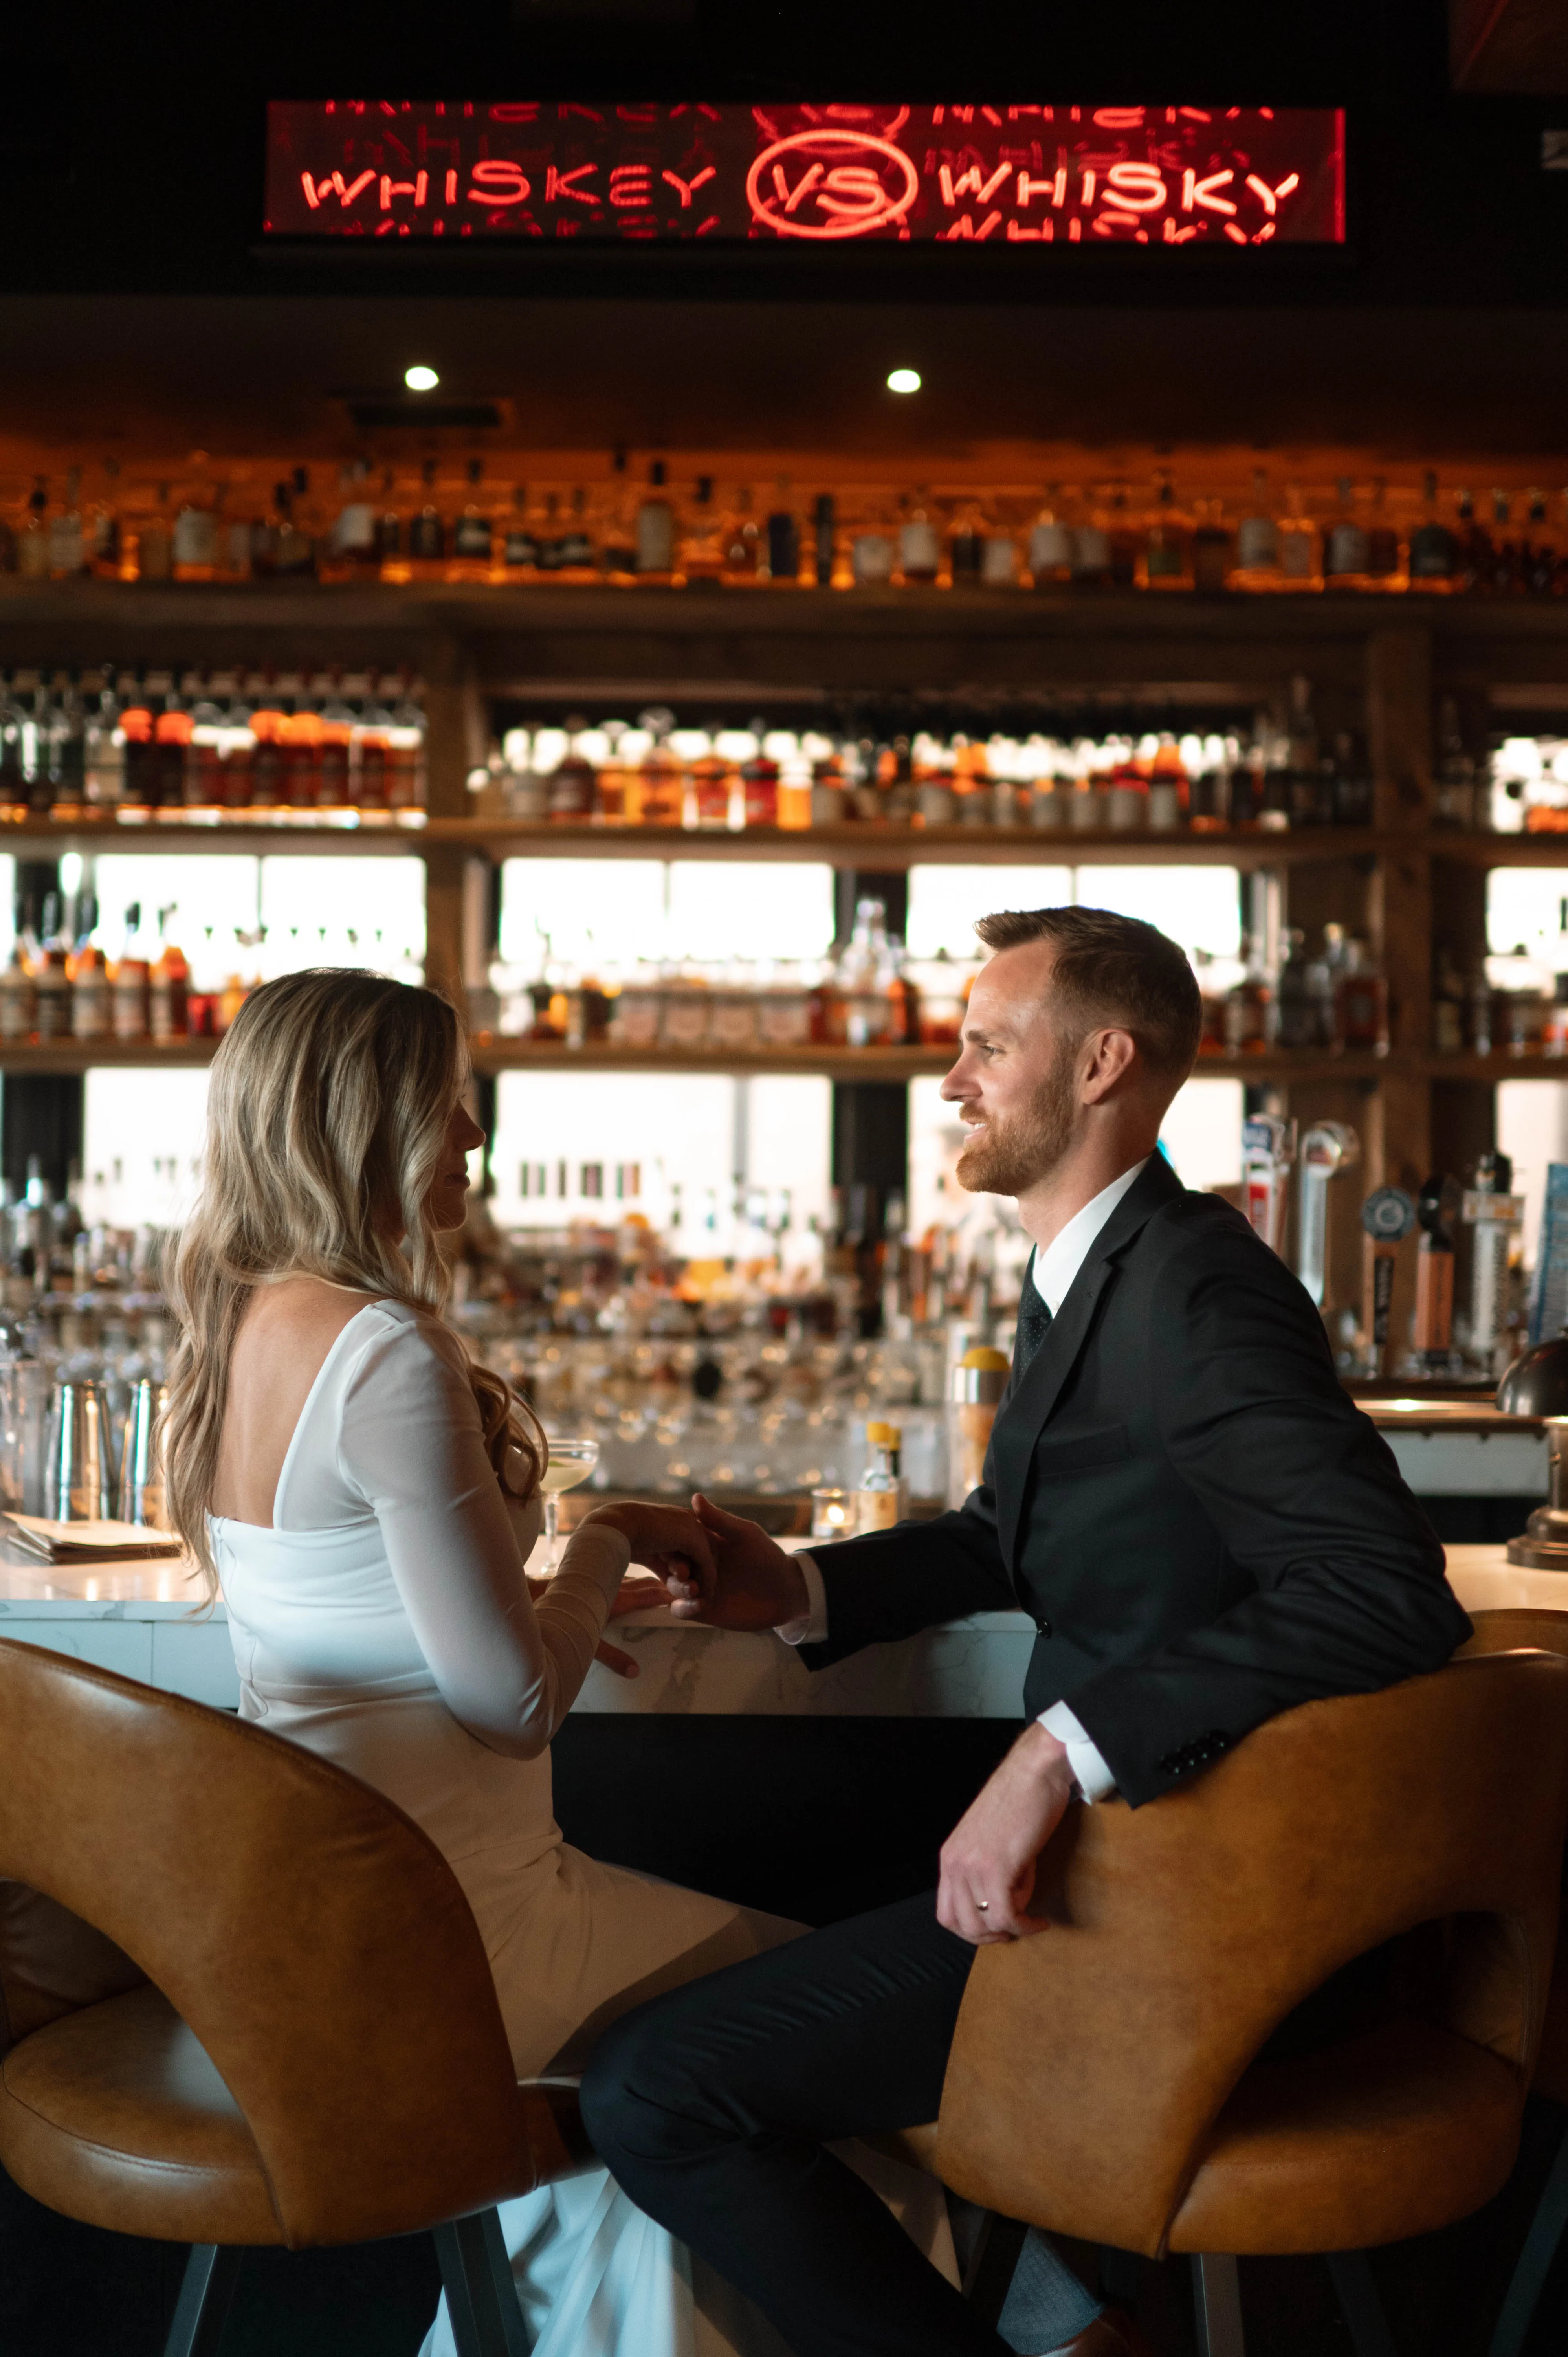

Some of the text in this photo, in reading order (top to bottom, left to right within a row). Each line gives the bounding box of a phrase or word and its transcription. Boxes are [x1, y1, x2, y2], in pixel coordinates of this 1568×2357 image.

[300, 160, 1300, 216] WHISKEY VS WHISKY
